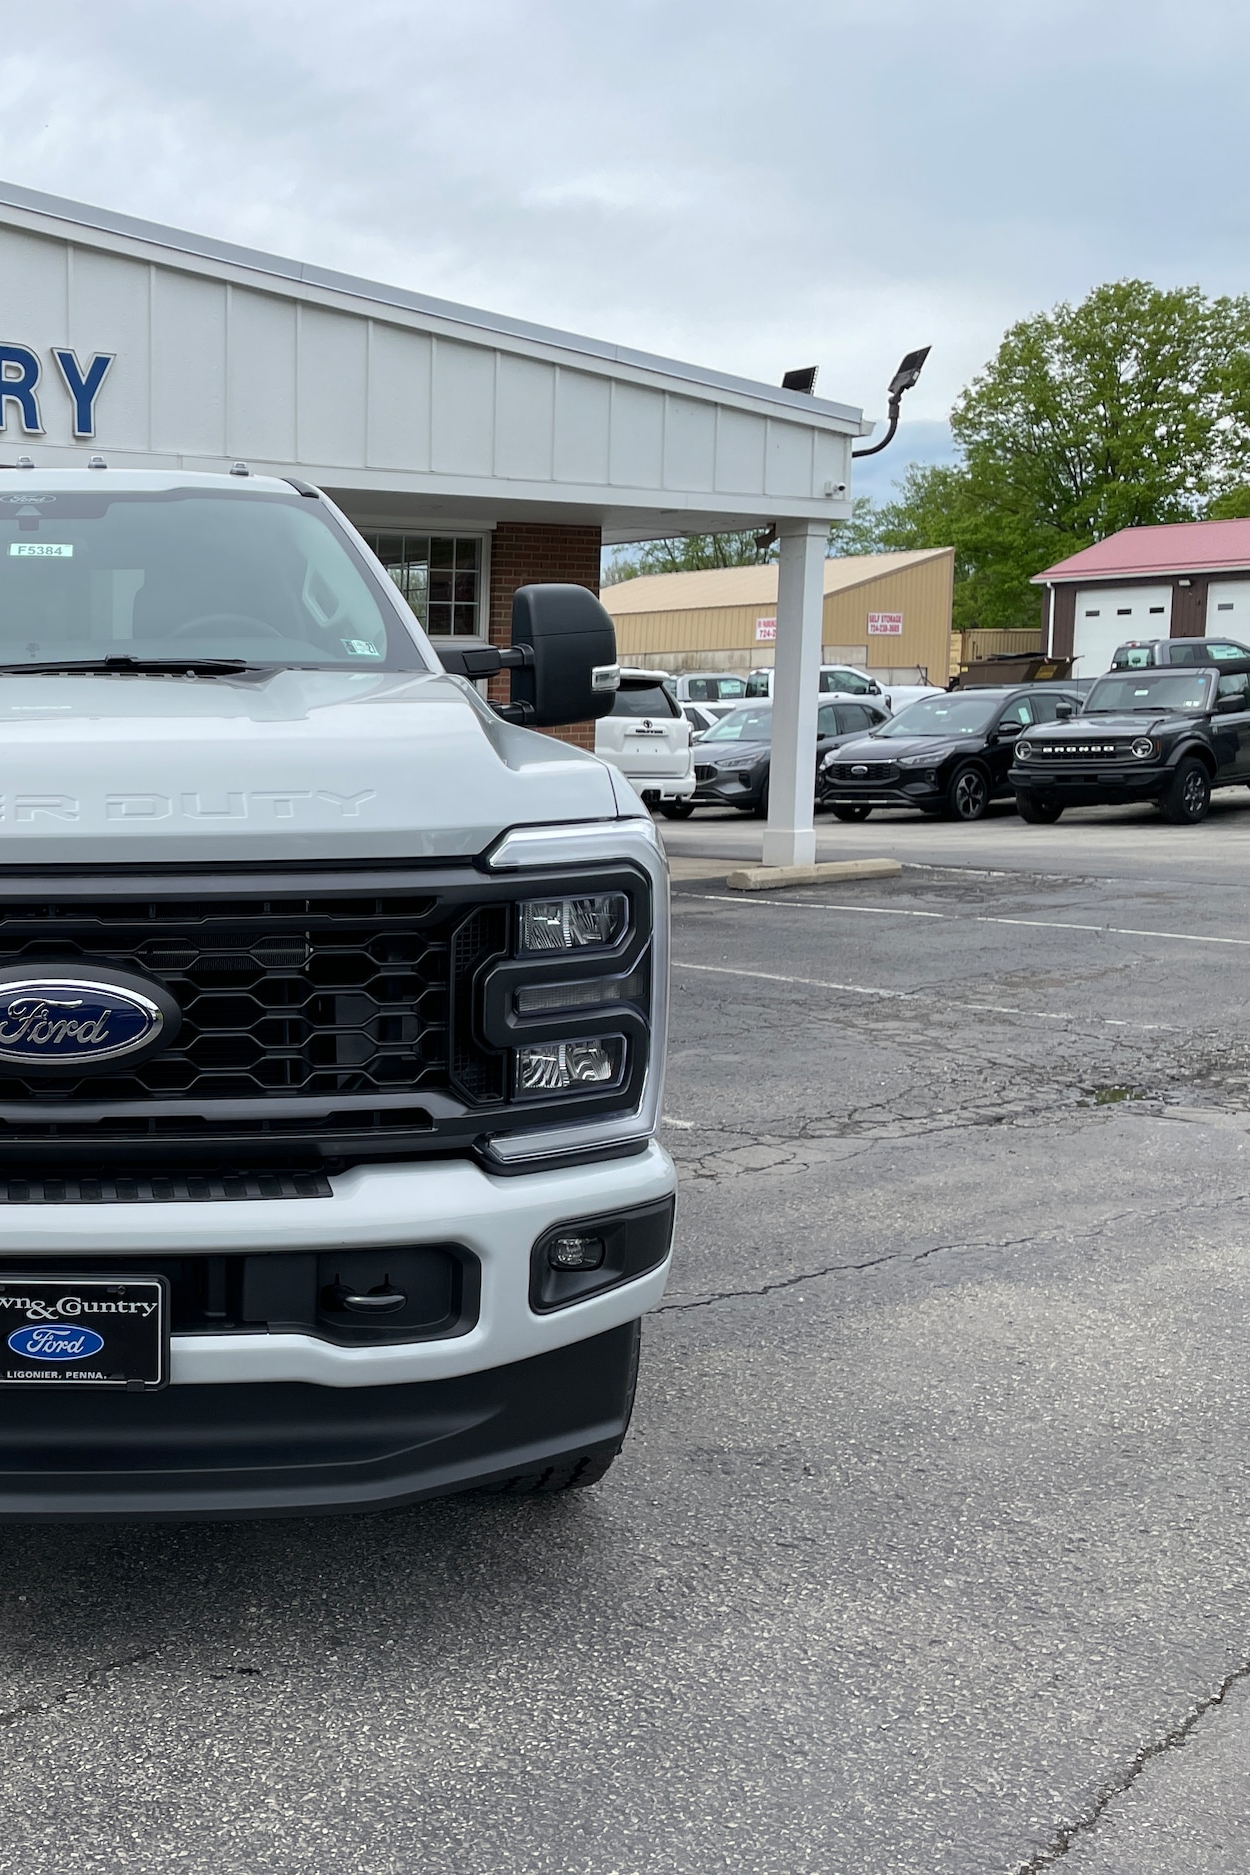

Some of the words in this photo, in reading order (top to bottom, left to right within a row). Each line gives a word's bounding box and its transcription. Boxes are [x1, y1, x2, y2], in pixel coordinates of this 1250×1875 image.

[17, 545, 63, 556] F5384
[105, 789, 377, 821] DUTY
[26, 1328, 86, 1354] Ford
[6, 1370, 62, 1379] LIGONIER,
[65, 1371, 108, 1380] PENNA.
